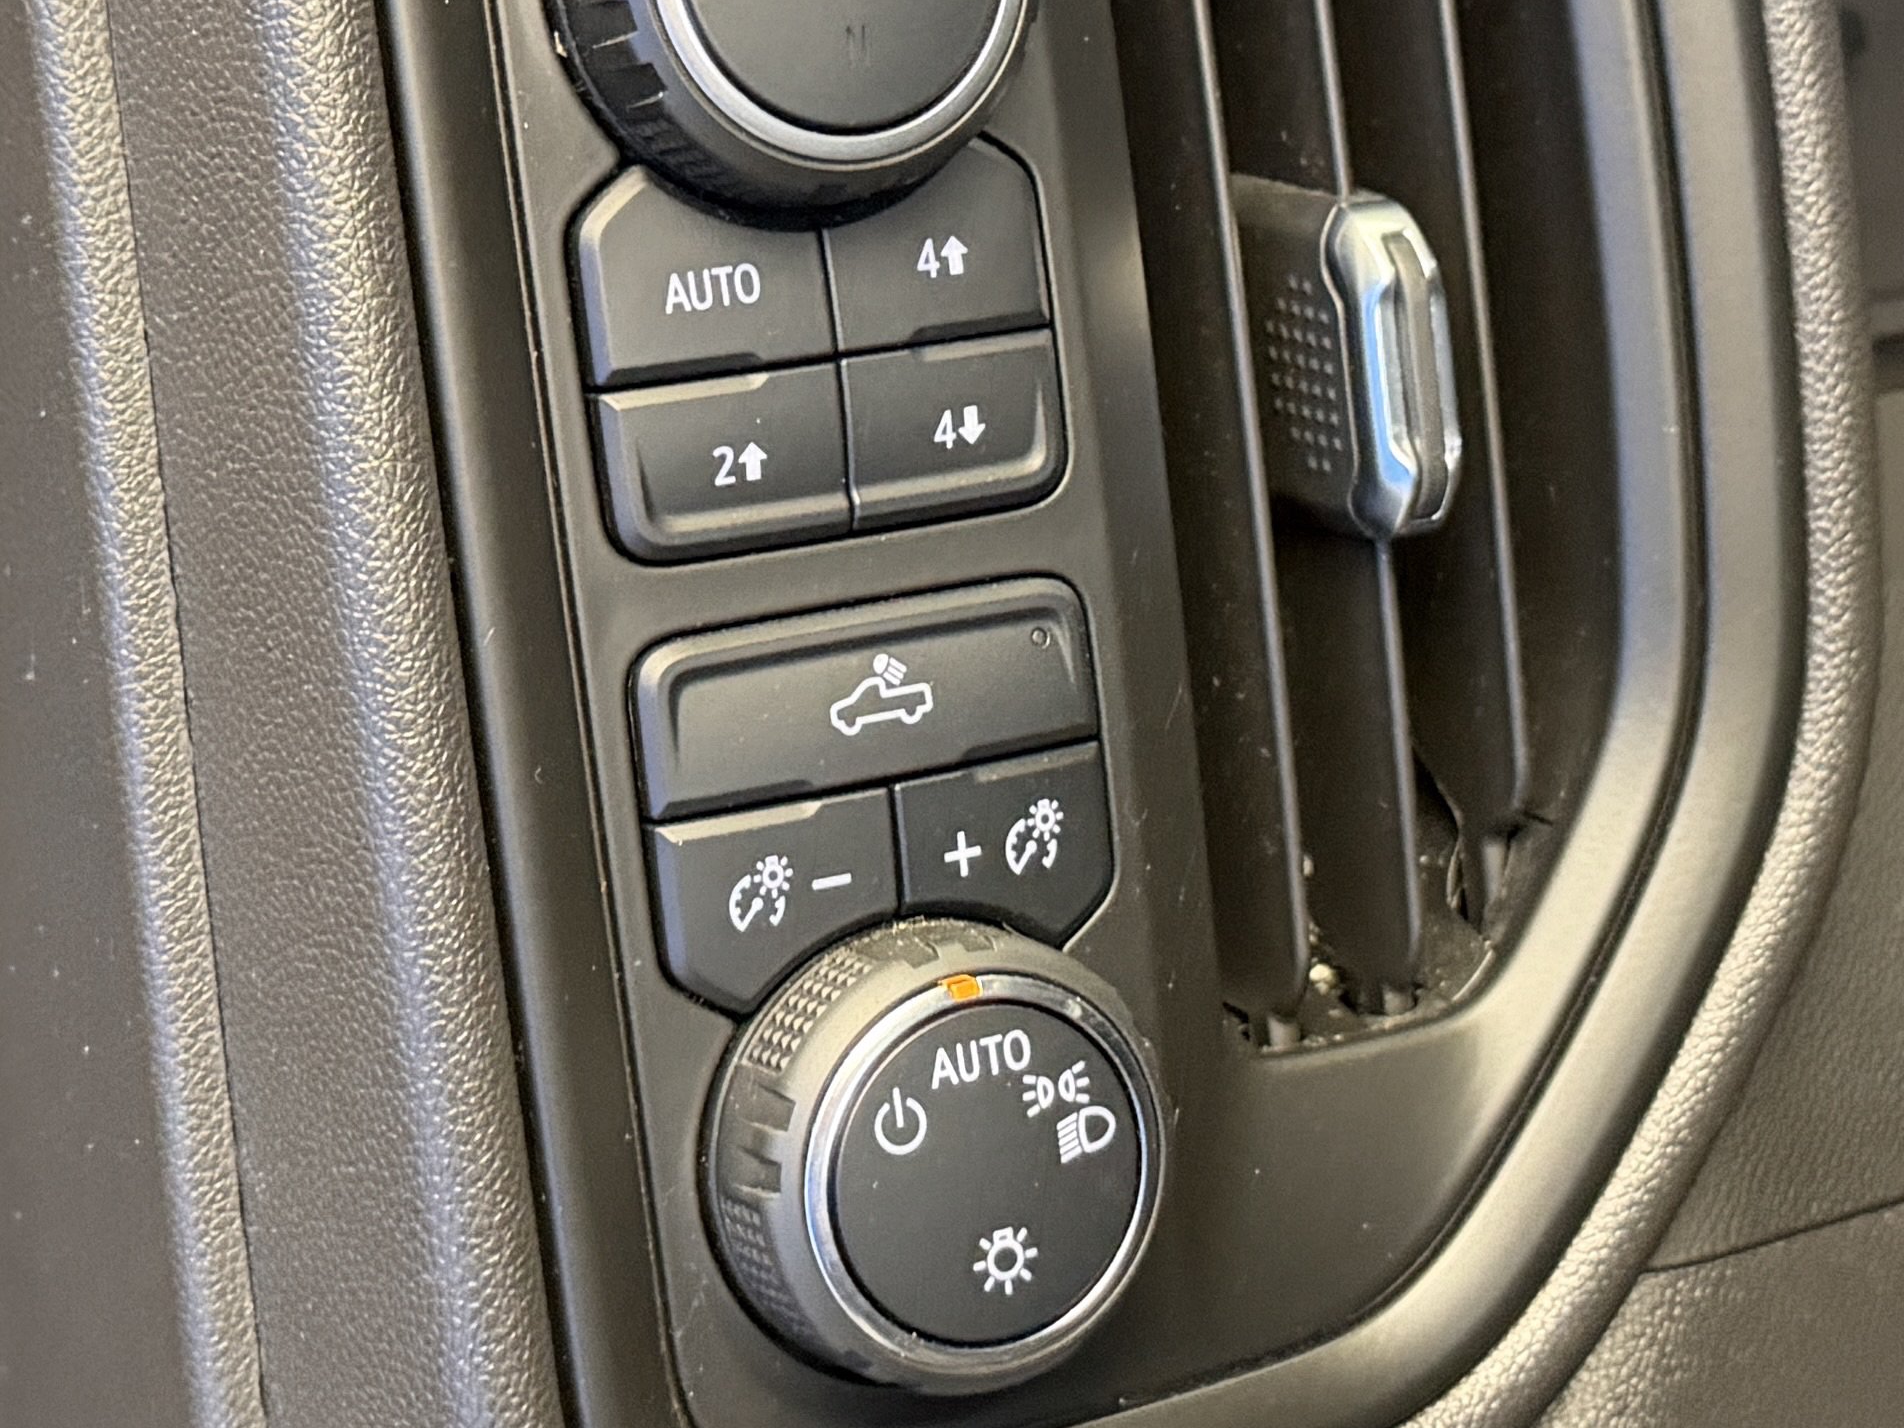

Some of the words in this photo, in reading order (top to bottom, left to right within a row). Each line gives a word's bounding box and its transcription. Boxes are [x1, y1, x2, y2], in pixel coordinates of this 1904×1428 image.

[916, 237, 941, 279] 4
[664, 262, 762, 315] AUTO
[933, 408, 957, 450] 4
[712, 445, 737, 487] 2
[931, 1028, 1032, 1090] AUTO
